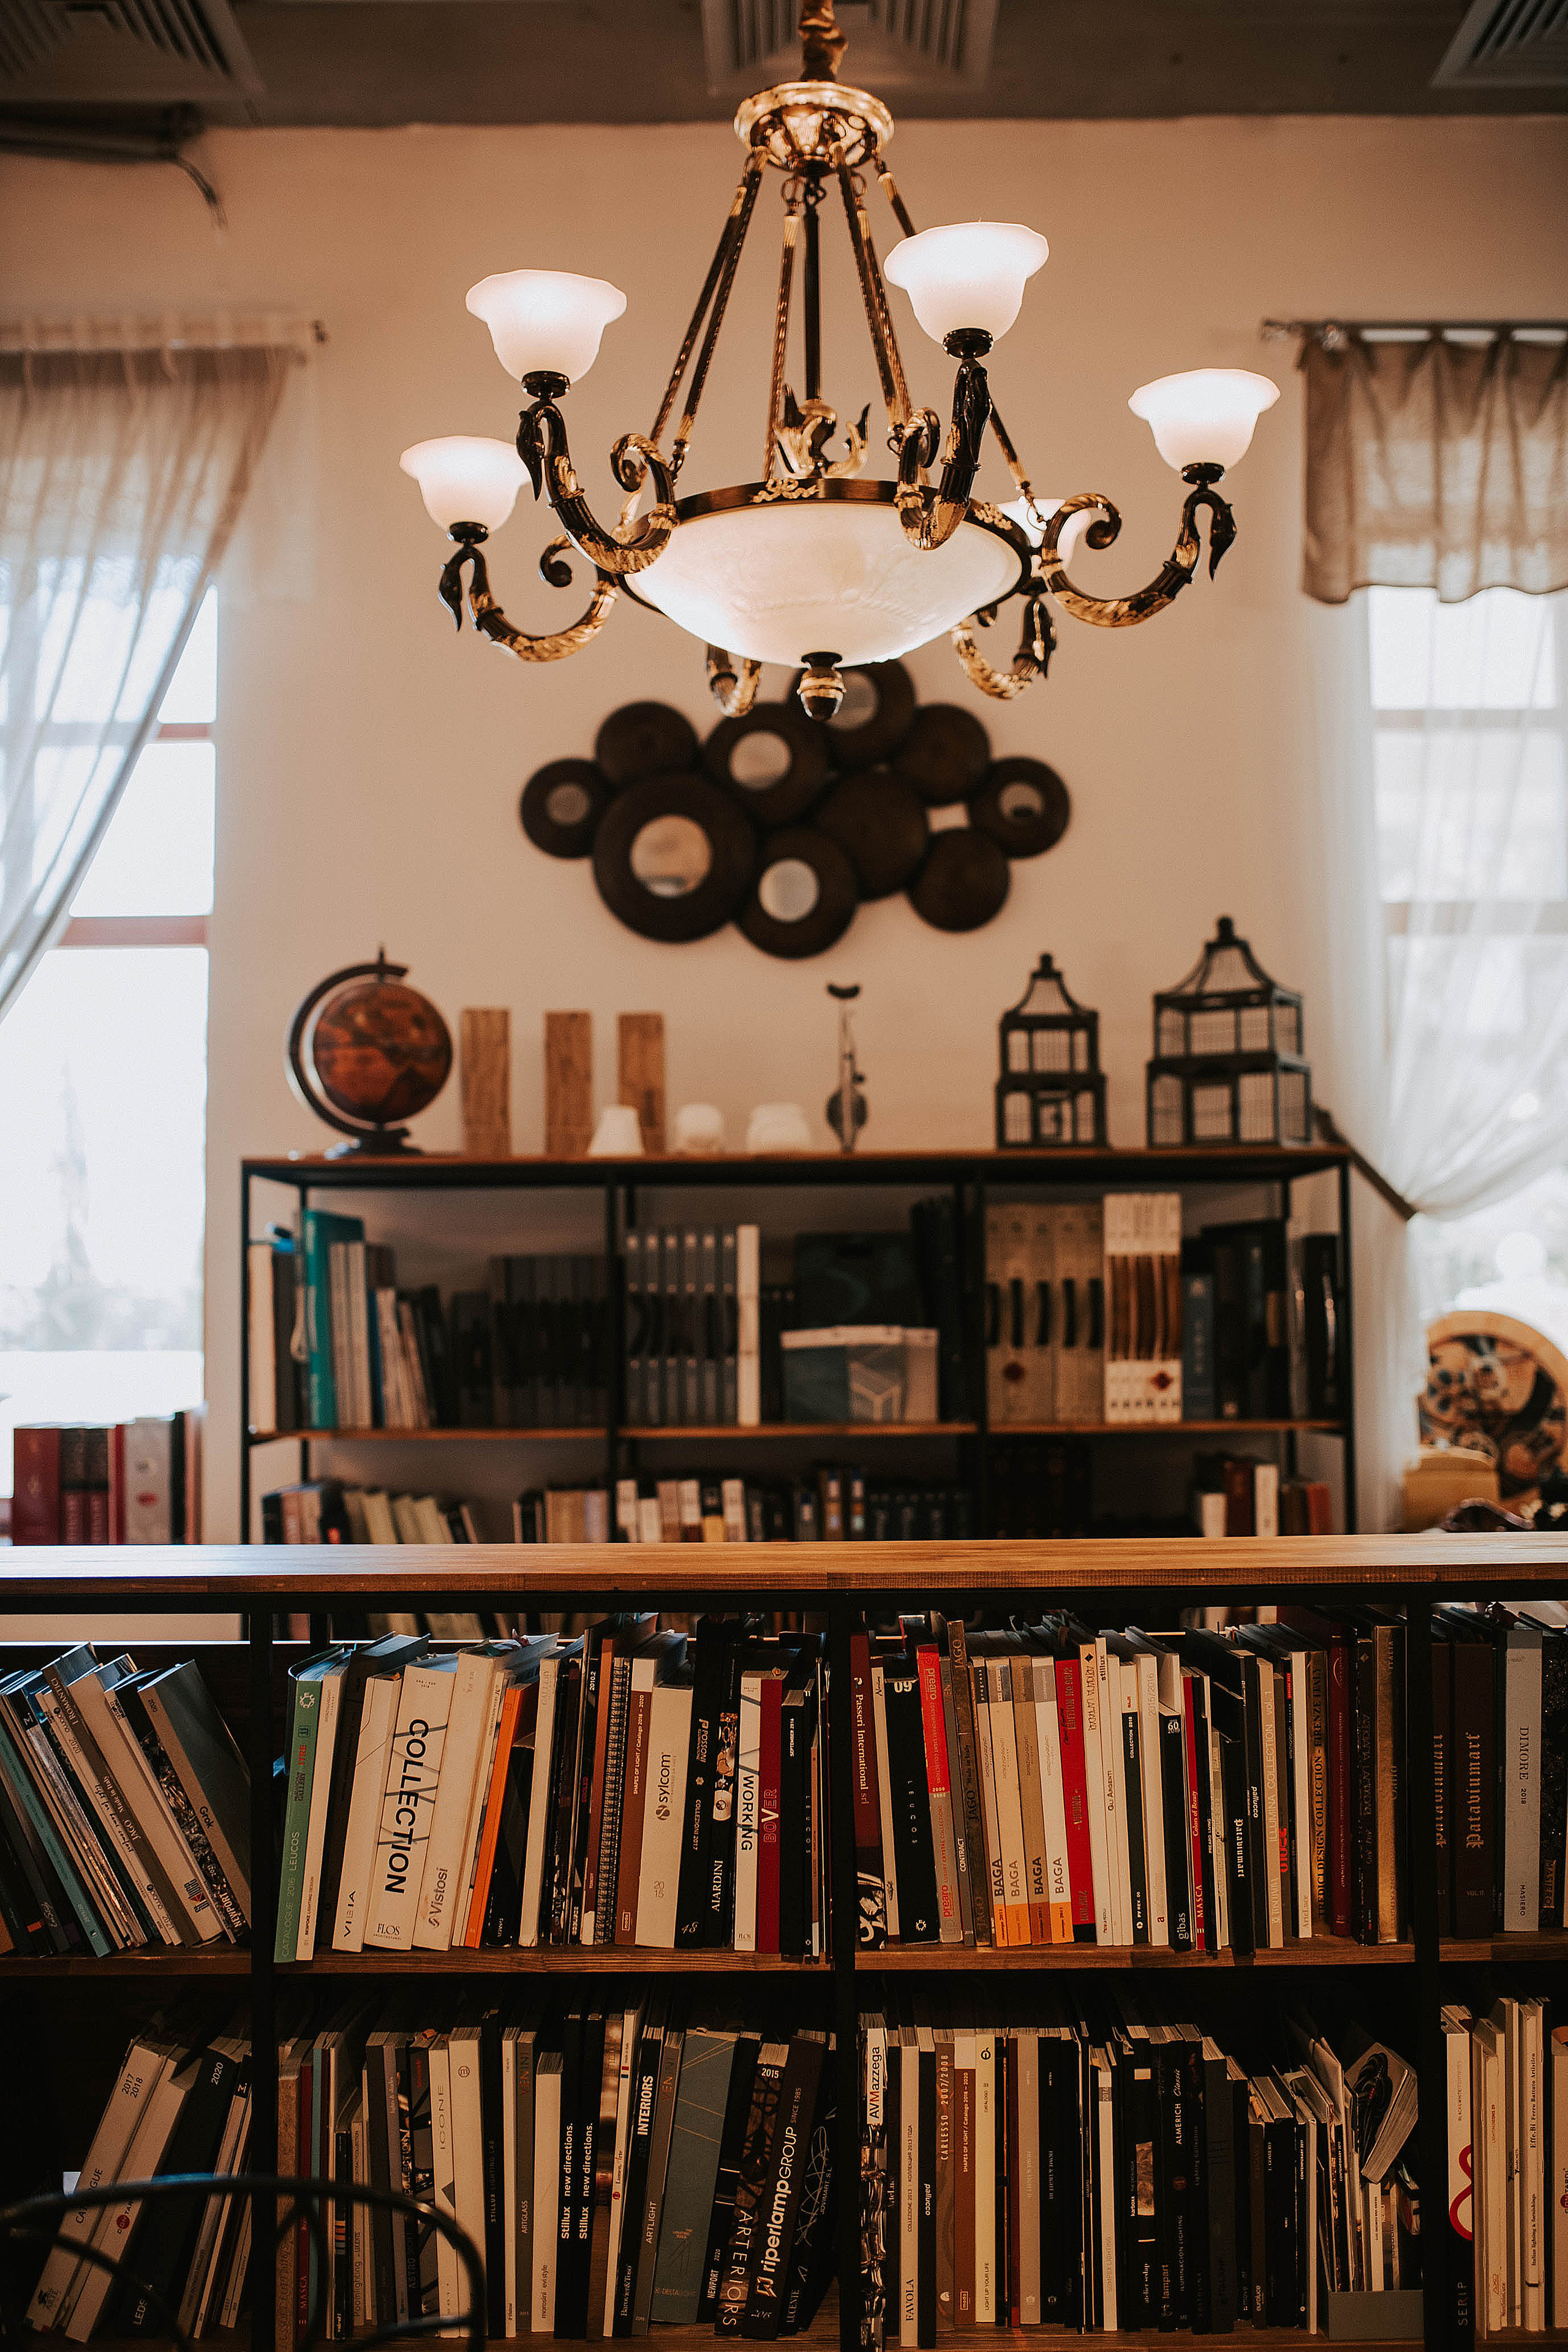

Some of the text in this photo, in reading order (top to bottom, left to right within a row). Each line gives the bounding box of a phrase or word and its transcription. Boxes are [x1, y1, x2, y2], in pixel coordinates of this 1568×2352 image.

[952, 1639, 967, 1670] JAGO
[929, 1667, 938, 1701] prearo
[1264, 1698, 1273, 1715] vol.
[1313, 1700, 1322, 1747] FIRENZE
[69, 1738, 81, 1755] 2020
[855, 1694, 870, 1804] Passeri International srl
[1264, 1724, 1276, 1789] COLLECTION
[1518, 1726, 1529, 1781] DIMORE
[658, 1754, 671, 1803] sylcom
[1314, 1755, 1324, 1827] COLLECTION
[112, 1796, 124, 1813] Made
[200, 1806, 214, 1829] Grok
[384, 1719, 429, 1894] COLLECTION
[741, 1775, 755, 1851] WORKING
[761, 1789, 779, 1843] BOVER
[908, 1779, 918, 1844] LEUCOS
[1267, 1794, 1278, 1842] ILLUMINA
[124, 1819, 141, 1841] JAGO
[1316, 1830, 1326, 1869] DESIGN
[289, 1831, 300, 1871] LEUCOS
[957, 1838, 967, 1872] CONTRACT
[429, 1868, 448, 1915] Vistosi
[711, 1860, 723, 1912] AIARDINI
[992, 1858, 1004, 1897] BAGA
[1009, 1860, 1020, 1897] BAGA
[1032, 1856, 1044, 1896] BAGA
[1053, 1857, 1065, 1894] BAGA
[1317, 1869, 1327, 1918] TREDICI
[1545, 1860, 1554, 1909] MASIERO
[220, 1892, 243, 1928] NEWPORT
[942, 1885, 953, 1918] prearo
[1196, 1884, 1204, 1918] MASCA
[377, 1923, 401, 1936] FLOS
[680, 1921, 699, 1934] 48
[1177, 1912, 1189, 1940] gibas
[122, 2073, 135, 2095] 2017
[129, 2077, 144, 2099] 2018
[210, 2062, 224, 2086] 2020
[761, 2068, 780, 2079] 2015
[869, 2046, 883, 2120] AVMazzega
[437, 2084, 447, 2149] ICONE
[637, 2075, 654, 2135] INTERIORS
[1174, 2103, 1183, 2145] ALMERICH
[563, 2122, 573, 2174] directions.
[582, 2122, 594, 2174] directions.
[761, 2087, 802, 2273] riperlampGROUP SINCE 1985
[561, 2206, 571, 2239] Stillux
[579, 2206, 589, 2239] Stillux
[645, 2201, 657, 2244] ARTLIGHT
[707, 2269, 720, 2299] NEWPORT
[722, 2209, 754, 2326] ARTERIORS
[1161, 2264, 1171, 2299] lampart
[786, 2290, 801, 2323] LUCENTE
[905, 2278, 914, 2321] FAVOLA
[1458, 2282, 1468, 2326] SERIP
